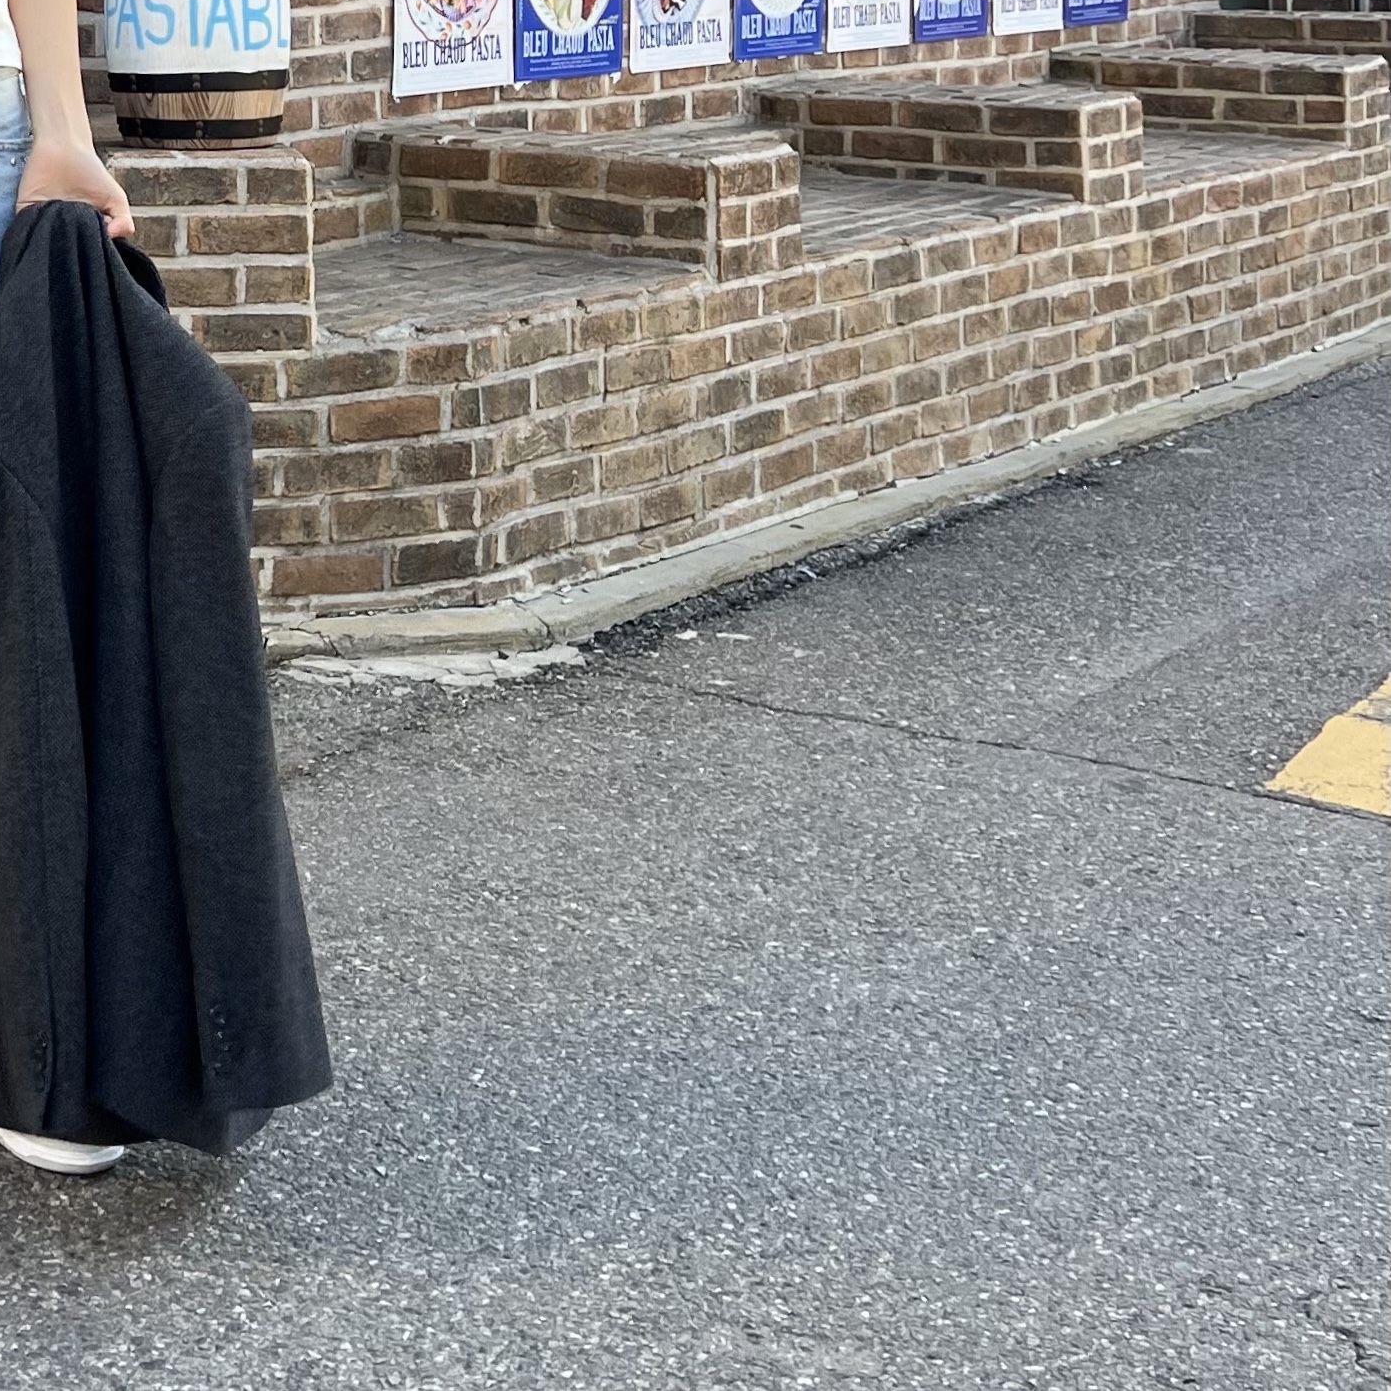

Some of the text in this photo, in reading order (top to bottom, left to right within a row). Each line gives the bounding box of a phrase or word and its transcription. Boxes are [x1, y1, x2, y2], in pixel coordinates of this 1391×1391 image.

[522, 29, 549, 58] BLEU
[587, 24, 615, 53] PASTA
[639, 23, 662, 50] BLEU
[665, 21, 694, 47] CHAUD
[696, 18, 722, 44] PASTA
[402, 34, 502, 69] BLEU CHAUD PASTA
